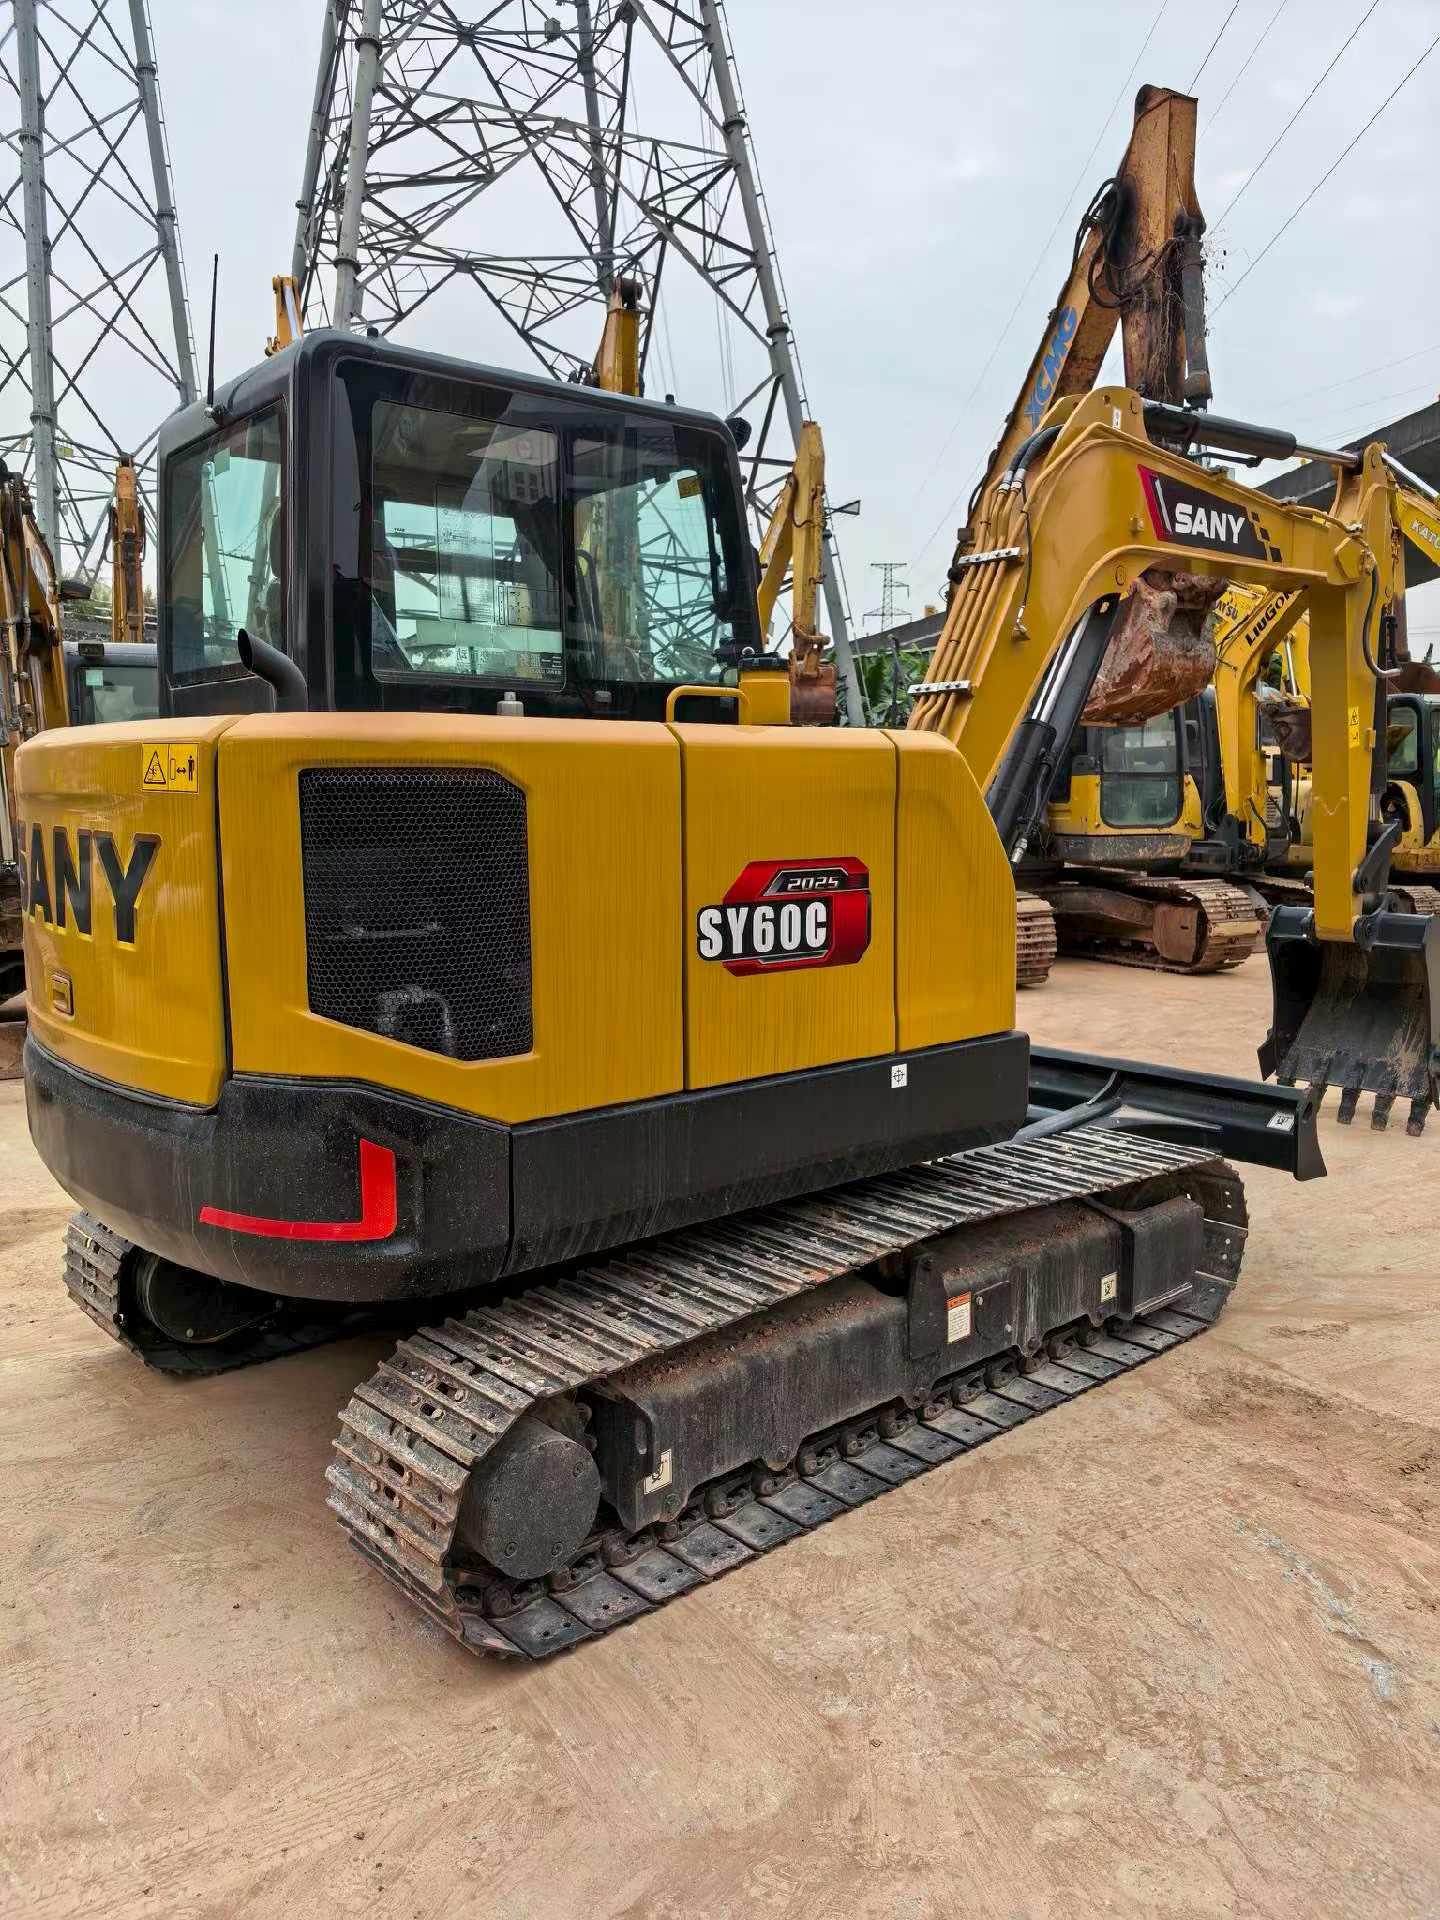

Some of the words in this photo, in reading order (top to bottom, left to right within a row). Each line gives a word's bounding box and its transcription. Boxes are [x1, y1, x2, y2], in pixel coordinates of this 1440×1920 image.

[1024, 305, 1077, 434] XCMG
[1175, 502, 1245, 544] SANY
[787, 876, 840, 891] 2025
[700, 901, 827, 958] SY60C
